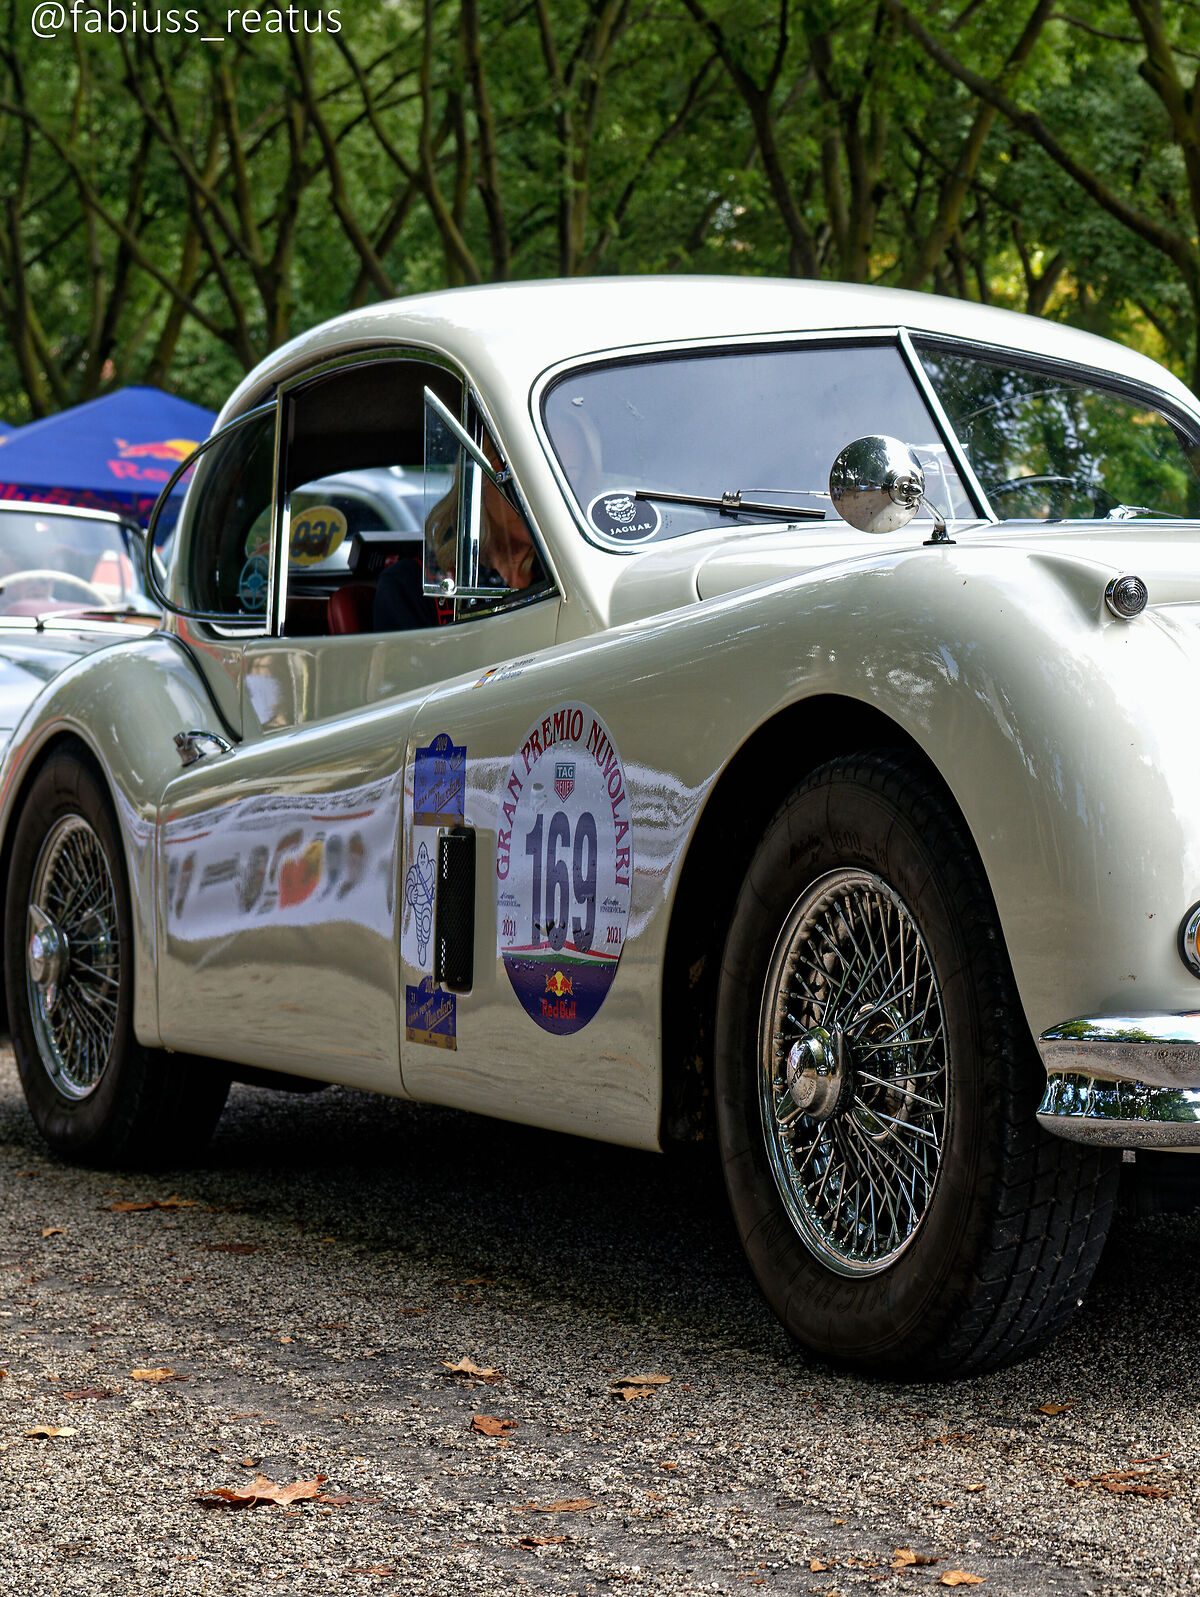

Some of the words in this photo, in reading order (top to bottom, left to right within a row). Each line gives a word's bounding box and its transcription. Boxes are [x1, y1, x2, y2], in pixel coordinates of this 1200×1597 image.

[610, 523, 652, 535] JAGUAR
[557, 766, 574, 779] TAG
[555, 779, 575, 798] HEUER
[496, 770, 524, 880] GRAN
[520, 709, 584, 776] PREMIO
[586, 719, 631, 888] NUVOLARI
[525, 810, 598, 954] 169
[502, 919, 516, 937] 2021
[606, 926, 621, 943] 2021
[542, 999, 559, 1018] Red
[559, 1000, 576, 1020] Bull
